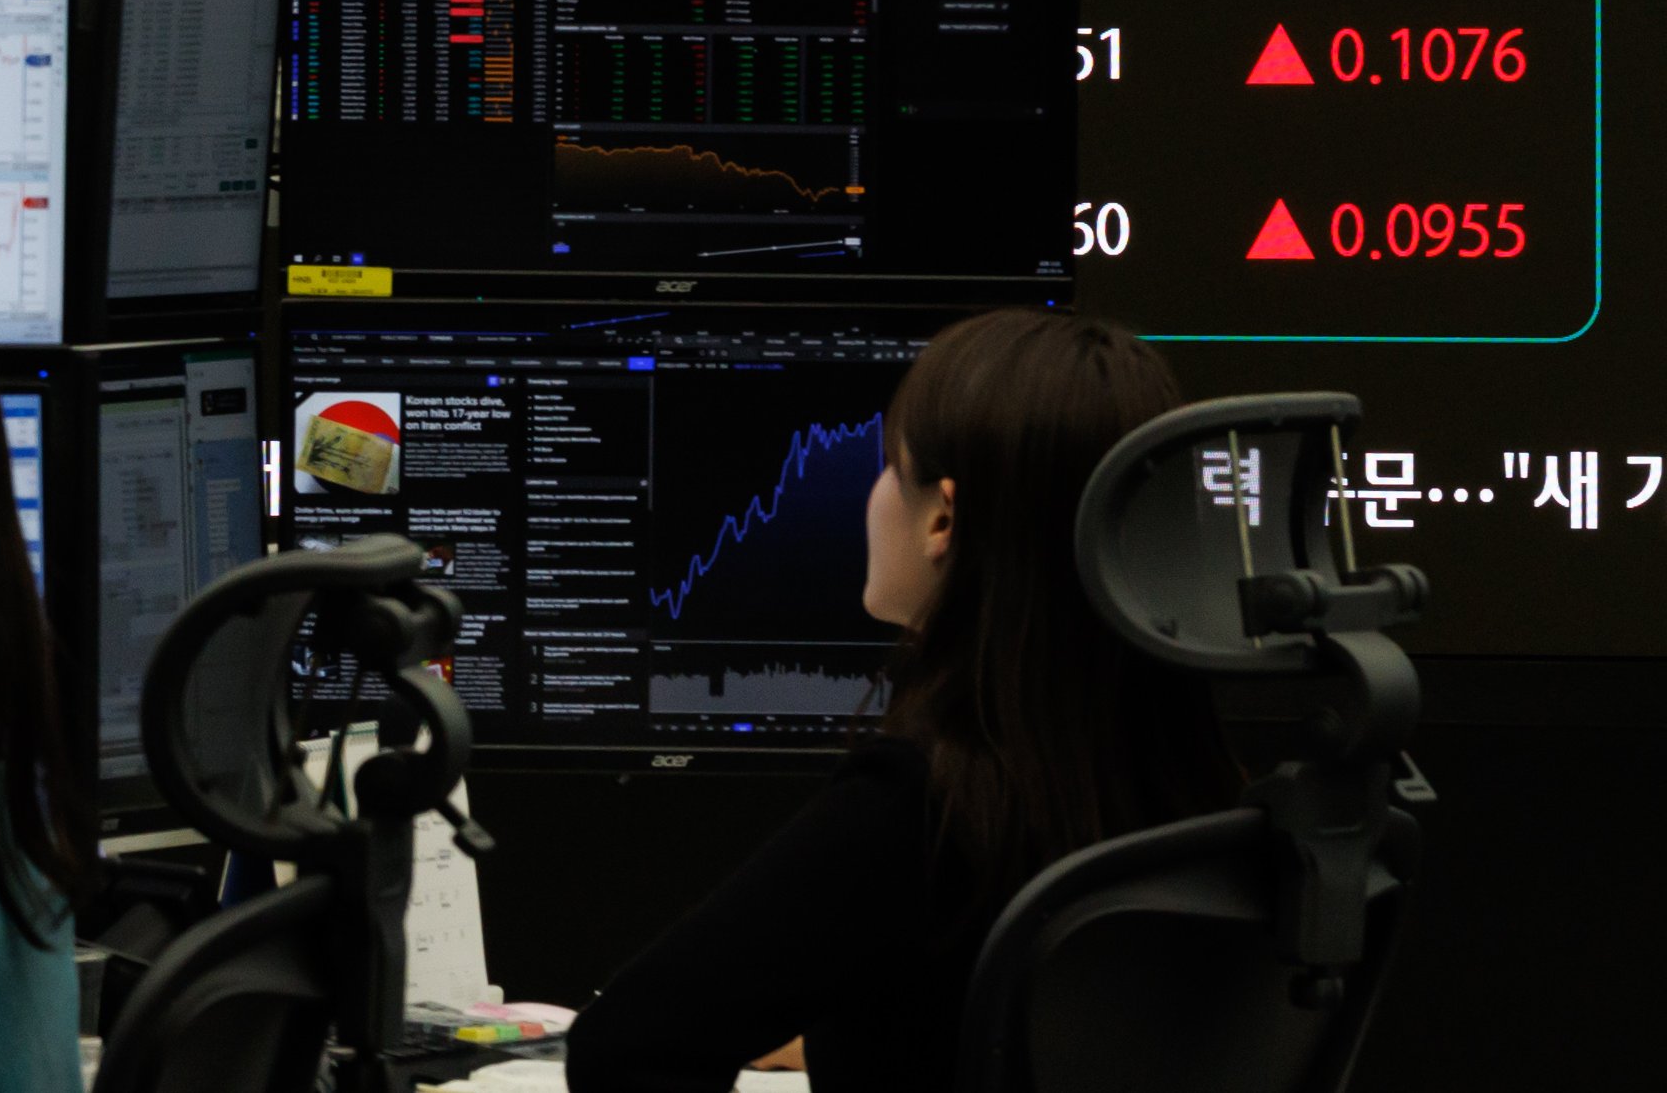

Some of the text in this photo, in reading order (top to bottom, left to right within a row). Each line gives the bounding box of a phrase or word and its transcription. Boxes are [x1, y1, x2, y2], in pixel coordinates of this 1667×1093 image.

[1328, 26, 1527, 86] 0.1076
[1328, 202, 1527, 263] 0.0955
[656, 280, 698, 293] acer
[405, 395, 443, 406] Korean
[445, 396, 478, 406] stocks
[405, 410, 428, 418] won
[430, 408, 450, 418] hits
[491, 409, 512, 419] low
[405, 422, 420, 430] on
[444, 421, 482, 431] conflict
[651, 755, 694, 768] acer
